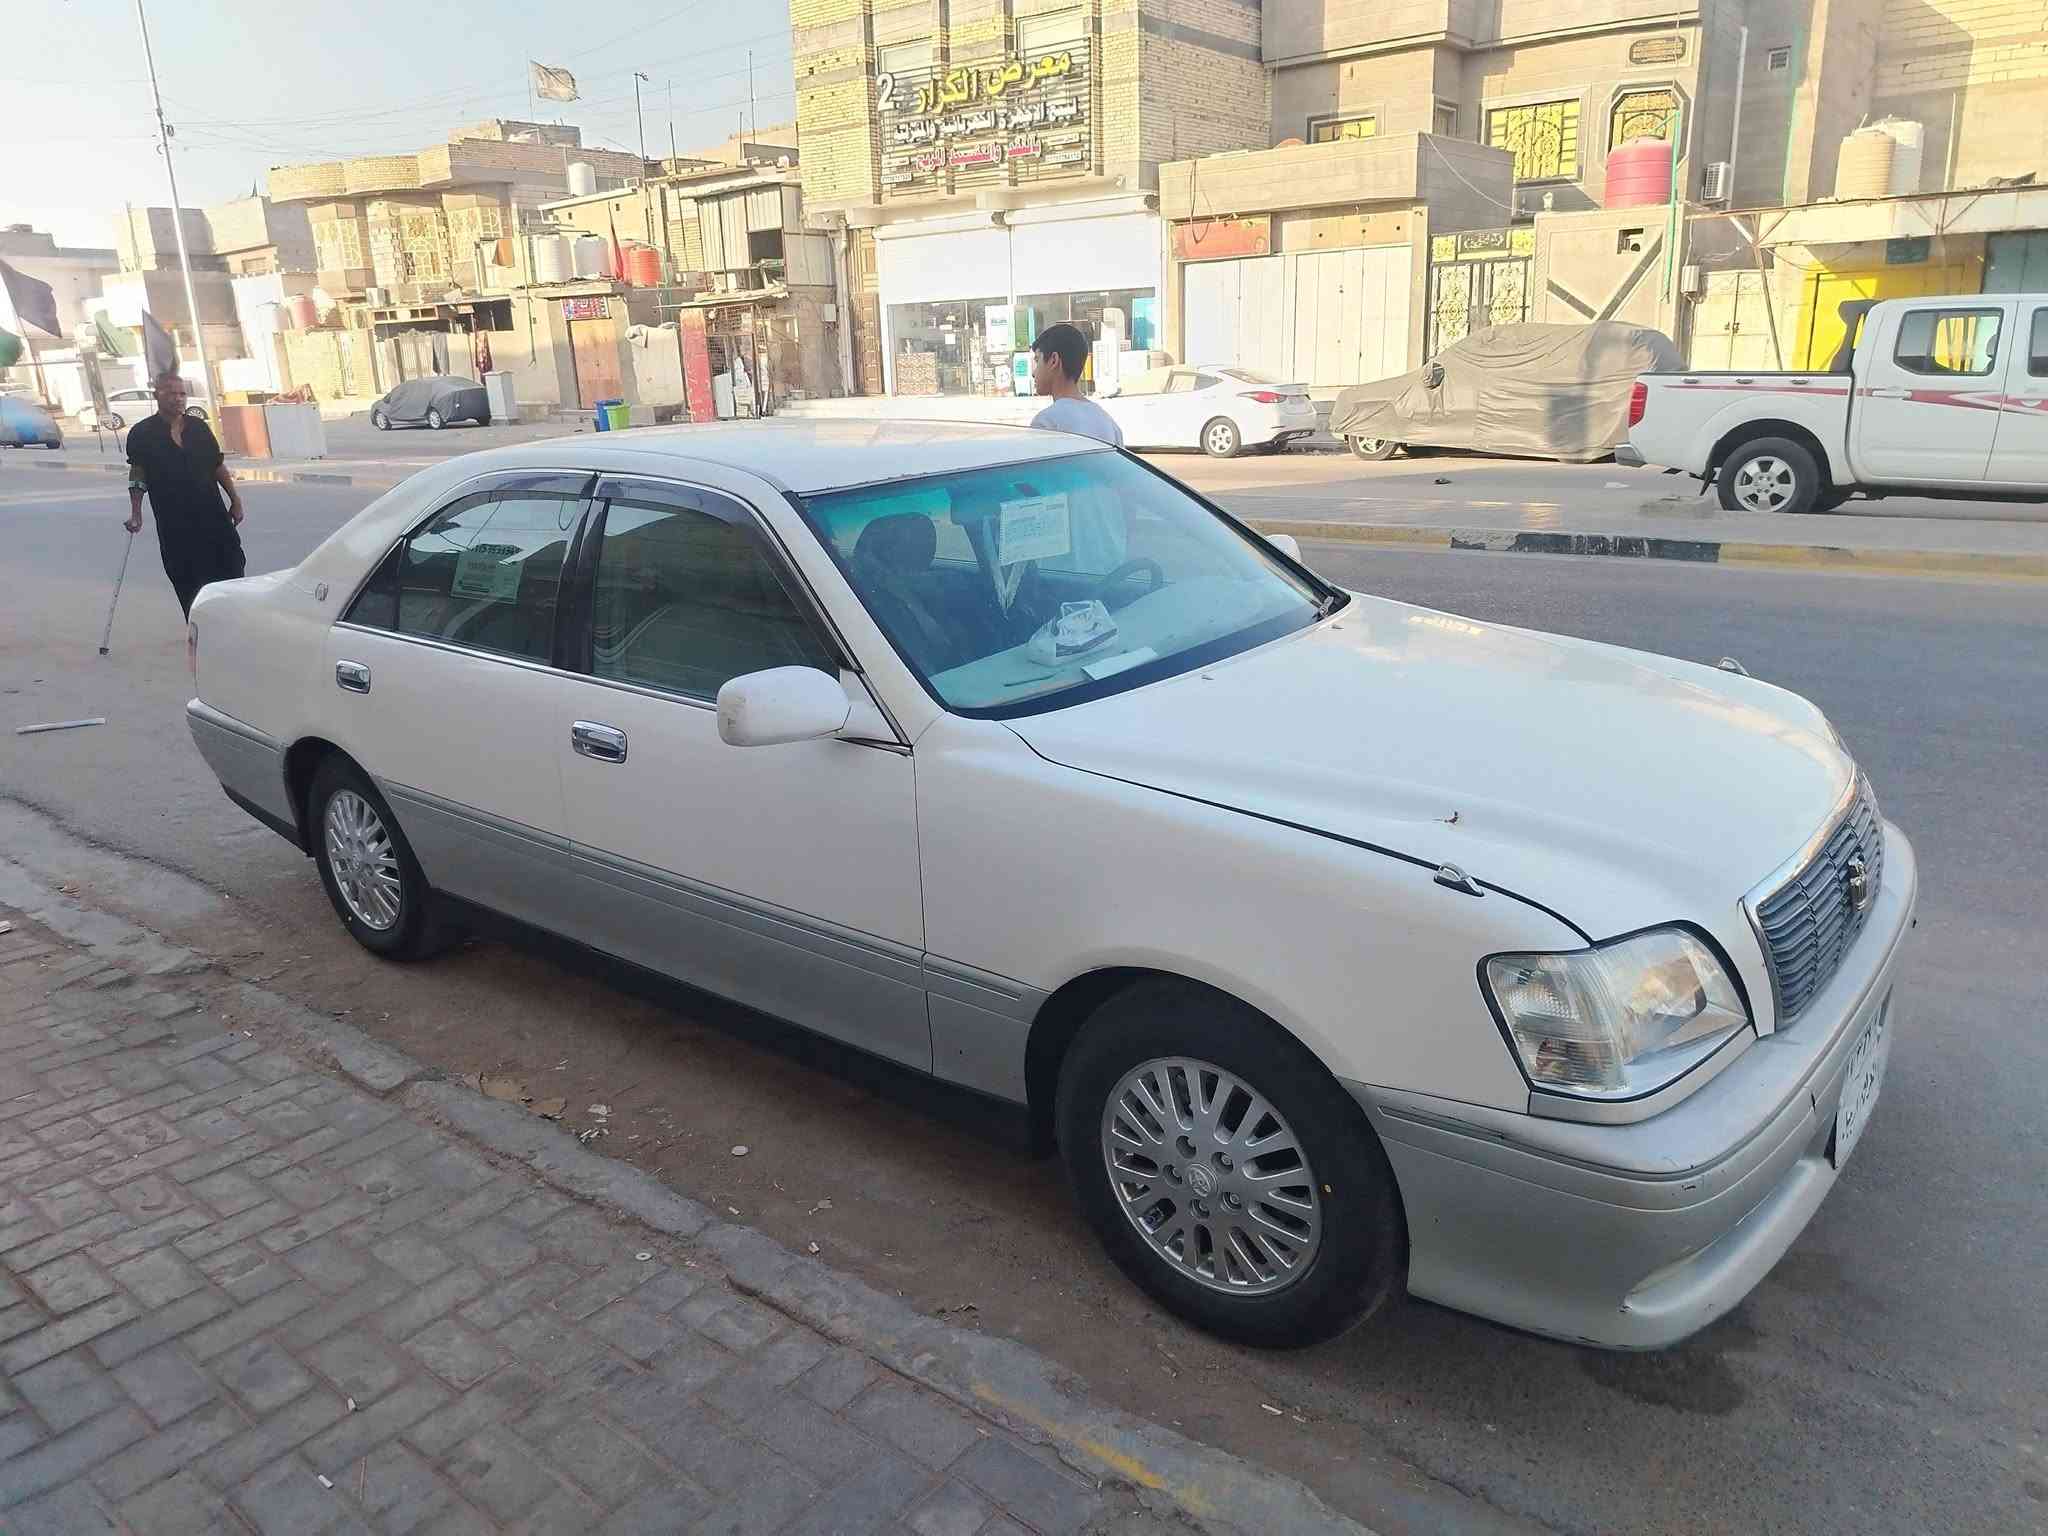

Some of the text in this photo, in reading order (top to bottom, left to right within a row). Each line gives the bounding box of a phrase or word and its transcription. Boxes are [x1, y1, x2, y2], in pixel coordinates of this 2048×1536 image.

[876, 51, 1071, 114] معرض الكرار 2
[1048, 96, 1077, 122] لبيع
